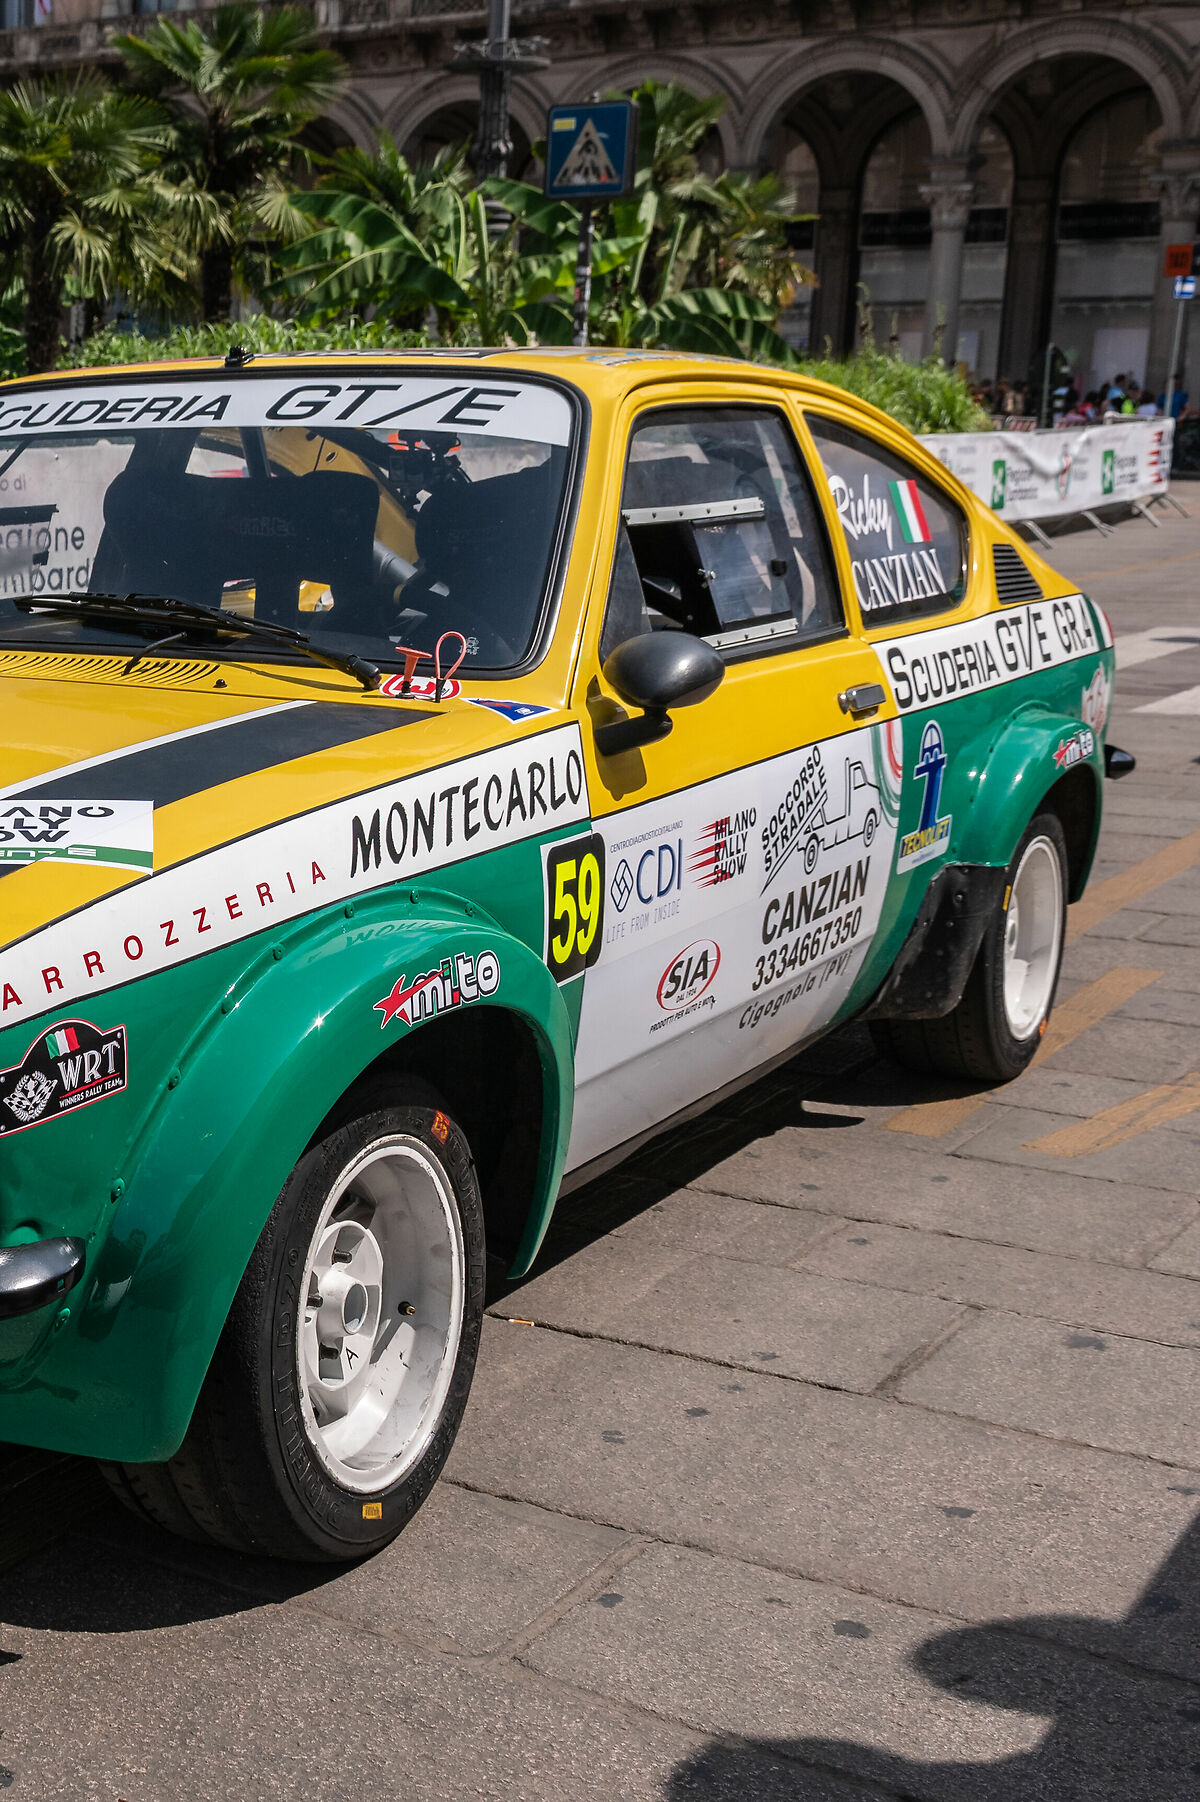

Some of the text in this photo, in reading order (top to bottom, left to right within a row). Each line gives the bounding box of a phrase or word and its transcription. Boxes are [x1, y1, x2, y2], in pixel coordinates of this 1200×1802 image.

[265, 384, 522, 427] GT/E
[828, 474, 893, 551] Ricky
[851, 549, 947, 611] CANZIAN
[887, 640, 1000, 709] SCUDERIA
[994, 606, 1051, 672] GT/E
[350, 749, 582, 879] MONTECARLO
[714, 807, 757, 842] MILANO
[761, 745, 821, 850] SOCCORSO
[764, 764, 827, 872] STRADALE
[714, 831, 748, 863] RALLY
[902, 818, 950, 857] TECNOLIFT
[636, 838, 683, 905] CDI
[713, 853, 748, 885] SHOW
[552, 853, 600, 964] 59
[606, 899, 681, 944] LIFE FROM INSIDE
[761, 855, 871, 945] CANZIAN
[663, 949, 709, 999] SIA
[752, 906, 862, 991] 3334667350
[739, 971, 814, 1029] Cigognola
[57, 1040, 121, 1091] WRT
[59, 1078, 120, 1108] WINNERS RALLY TEAM
